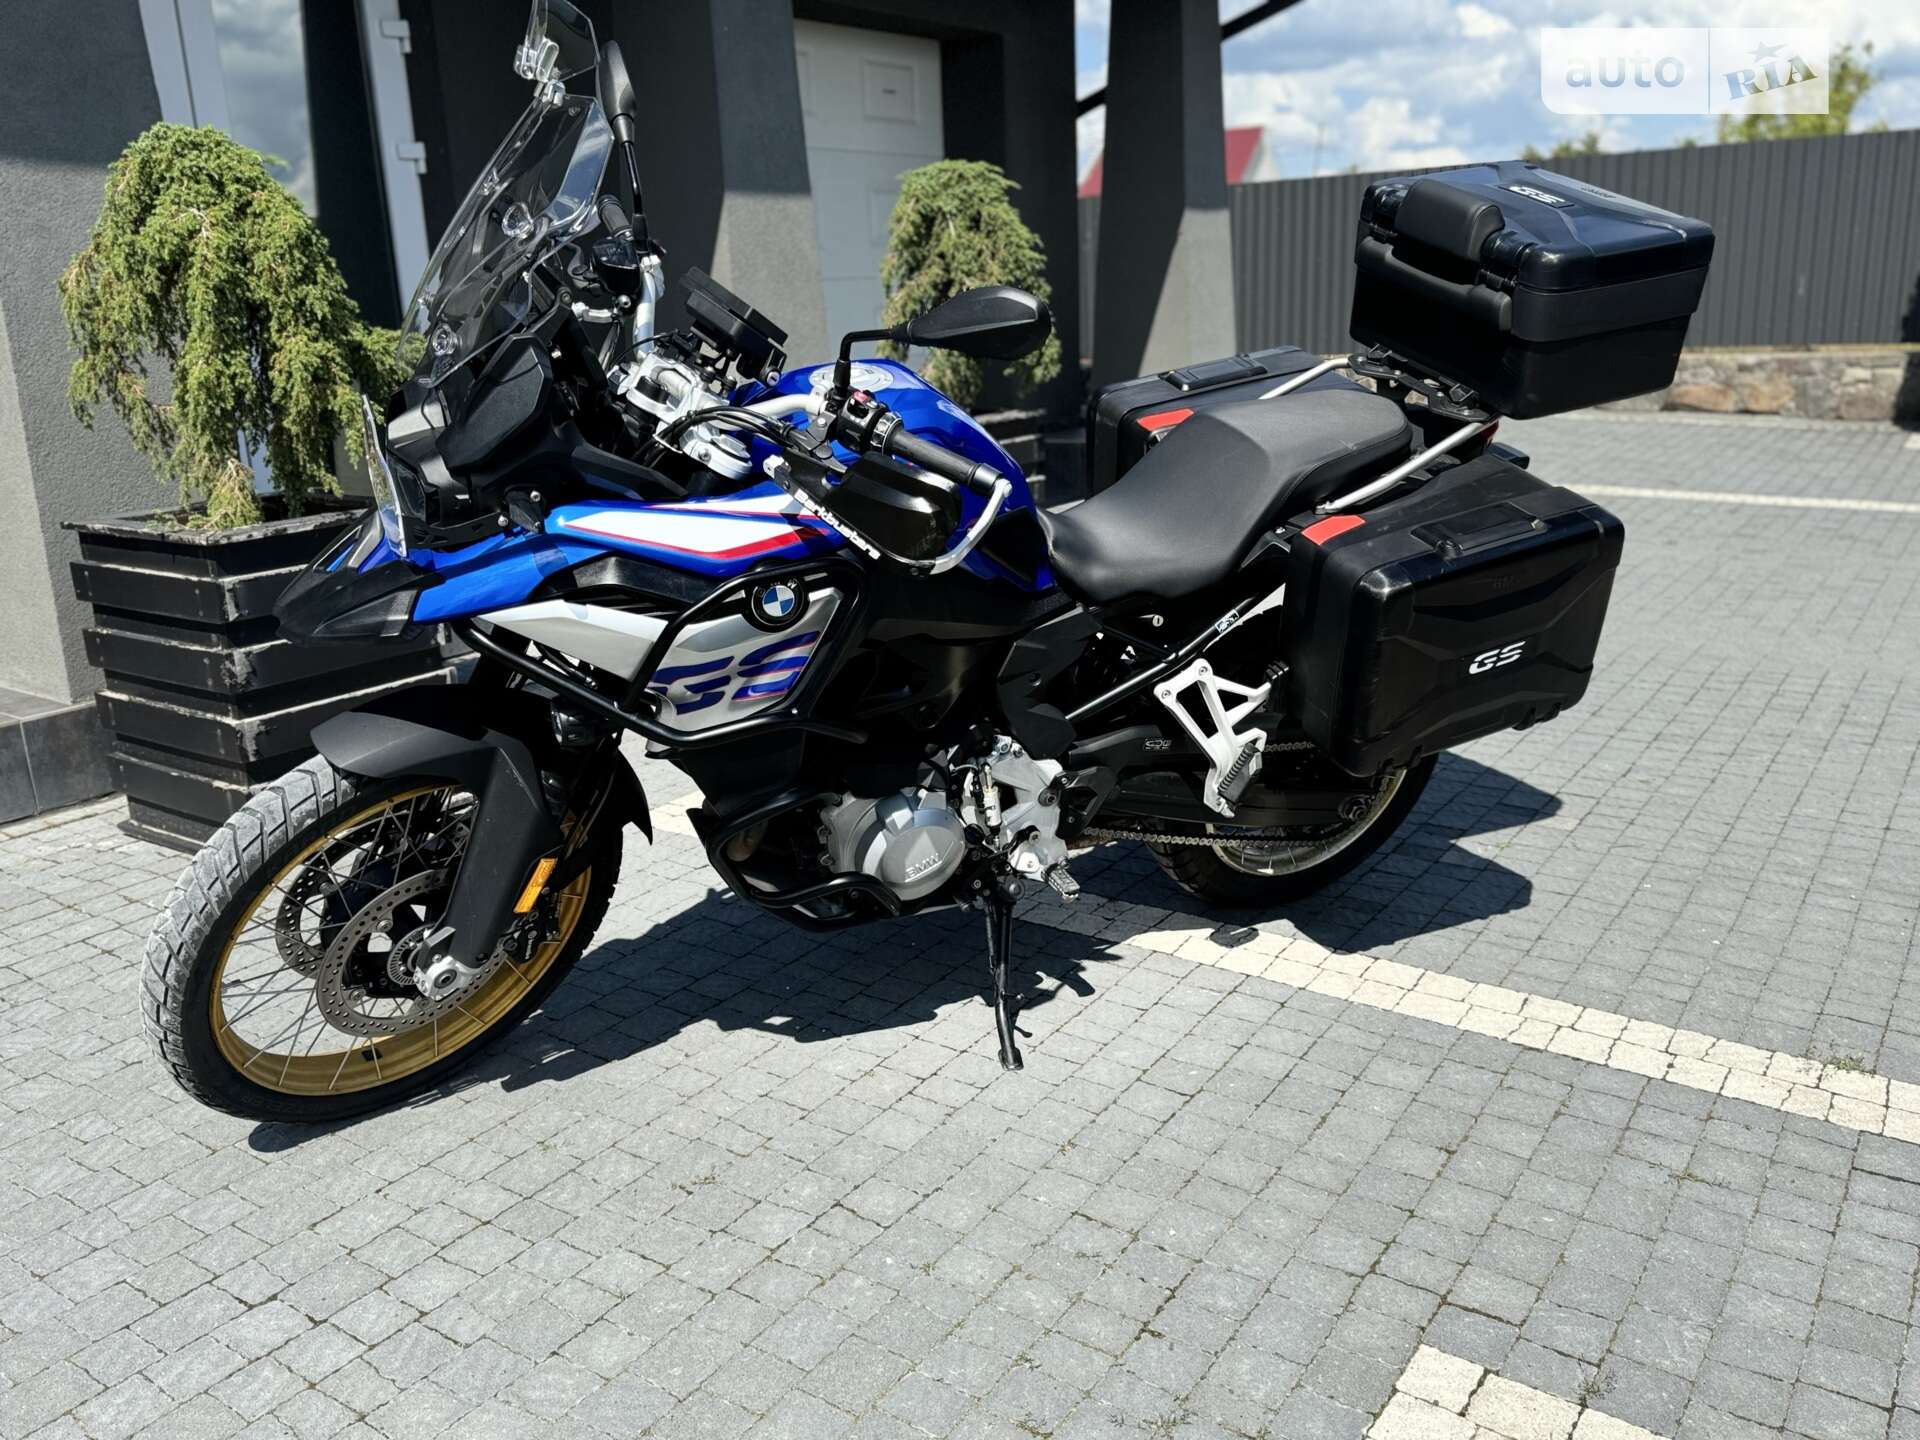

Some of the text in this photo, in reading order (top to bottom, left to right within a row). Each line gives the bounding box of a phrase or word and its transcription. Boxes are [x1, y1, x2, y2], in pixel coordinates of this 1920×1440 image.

[794, 488, 881, 560] Barkbusters
[648, 630, 820, 715] GS
[1469, 640, 1526, 675] GS
